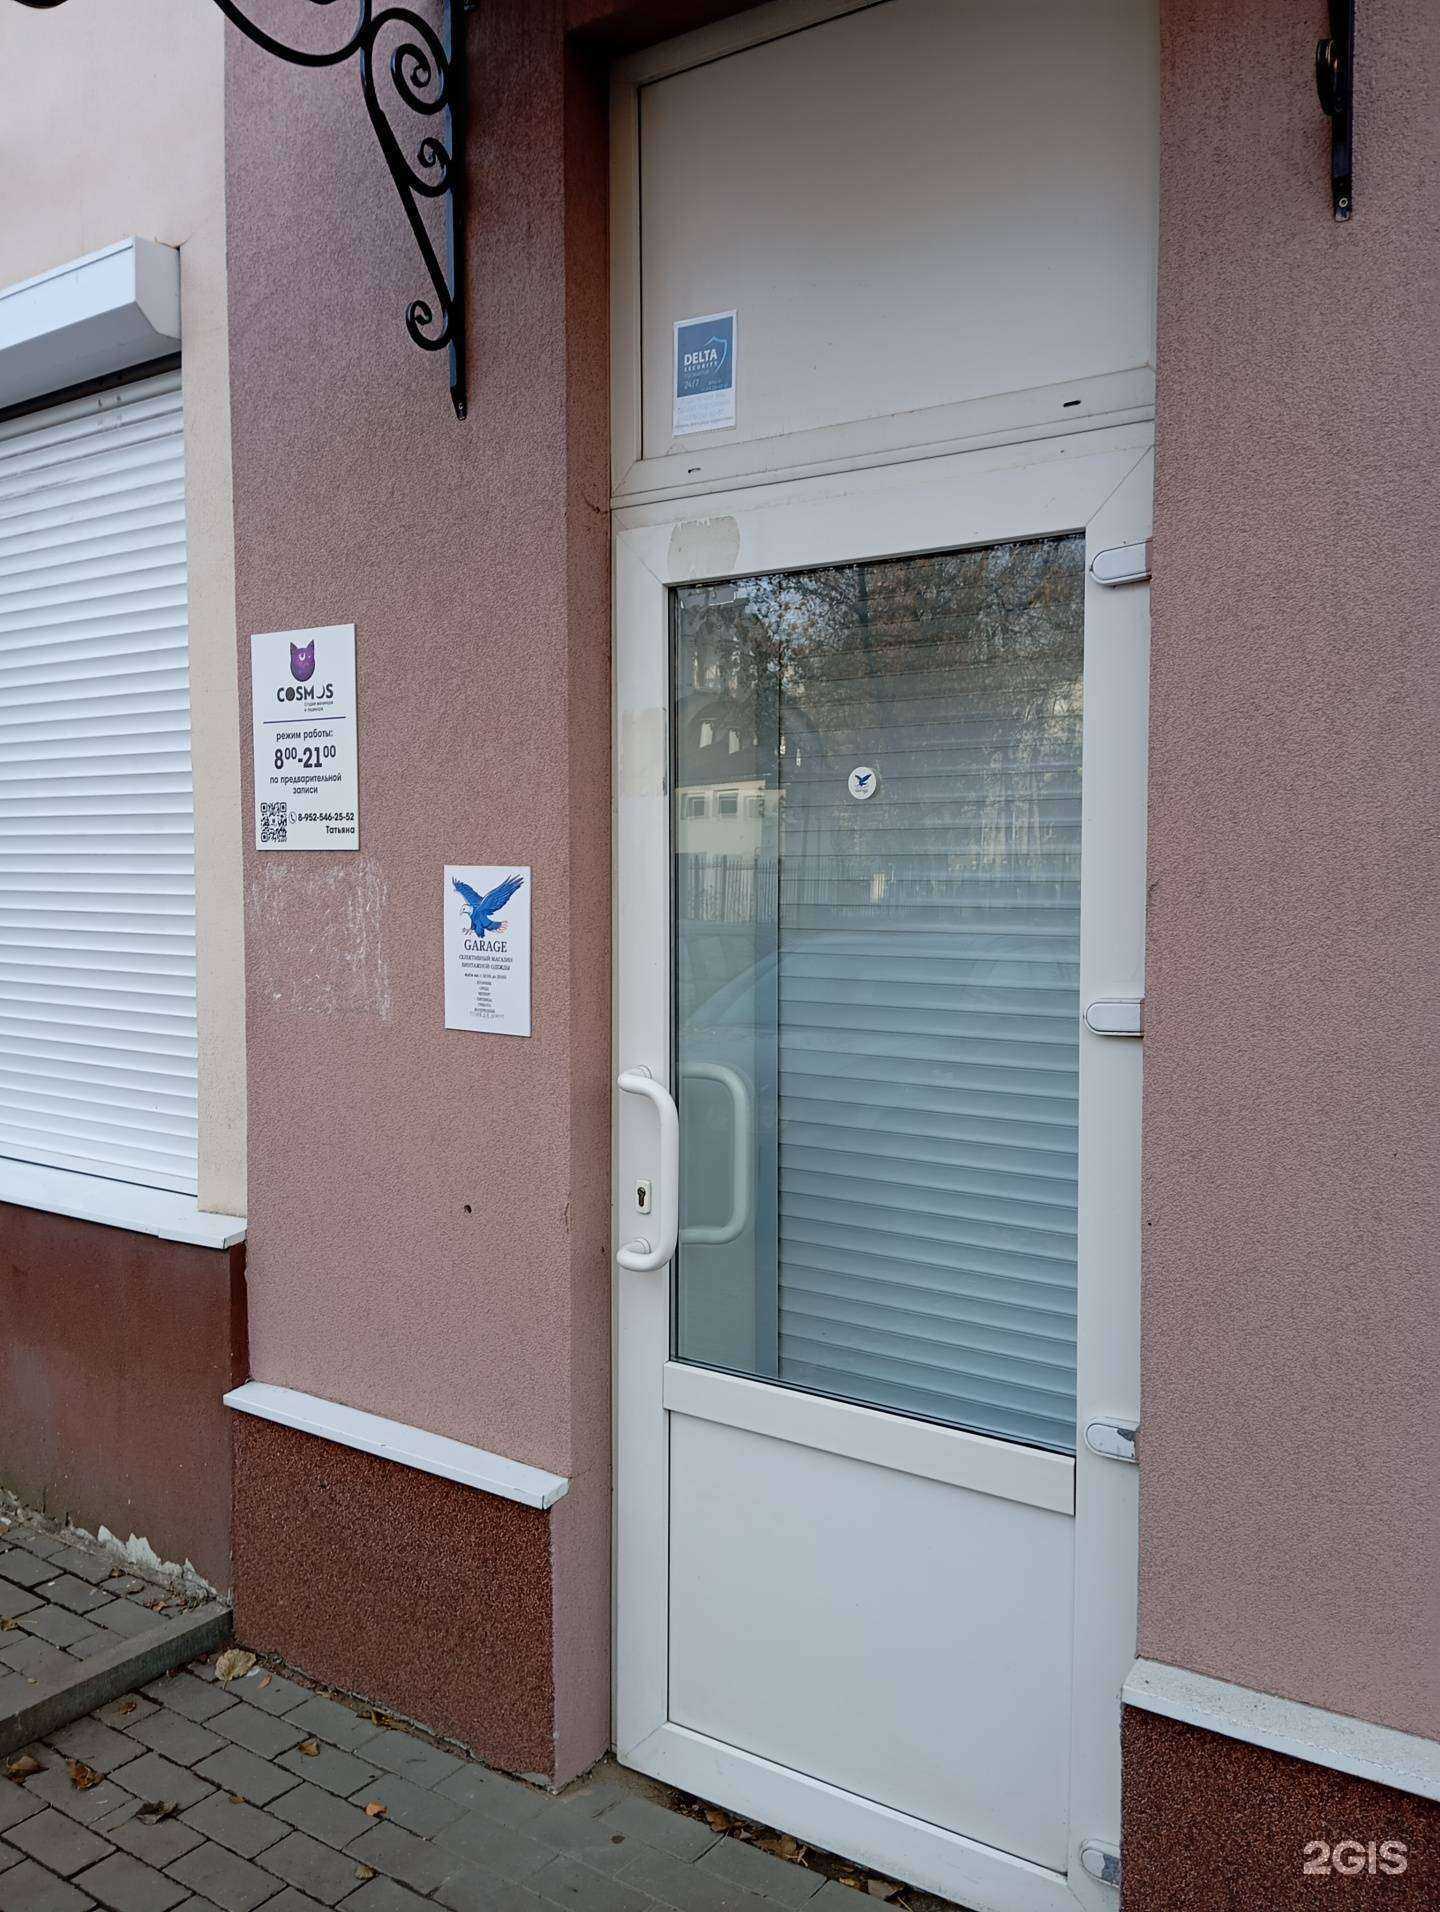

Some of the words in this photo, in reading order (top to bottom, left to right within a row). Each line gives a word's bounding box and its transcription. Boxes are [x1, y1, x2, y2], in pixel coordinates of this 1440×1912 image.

[684, 349, 718, 366] DELTA
[276, 731, 301, 742] режим
[303, 728, 333, 741] работы:
[269, 776, 279, 784] по
[280, 772, 342, 785] предварительной
[292, 786, 319, 794] записи
[297, 811, 355, 821] 8-952-546-25-52
[326, 825, 355, 834] Татьяна
[464, 939, 508, 953] GARAGE
